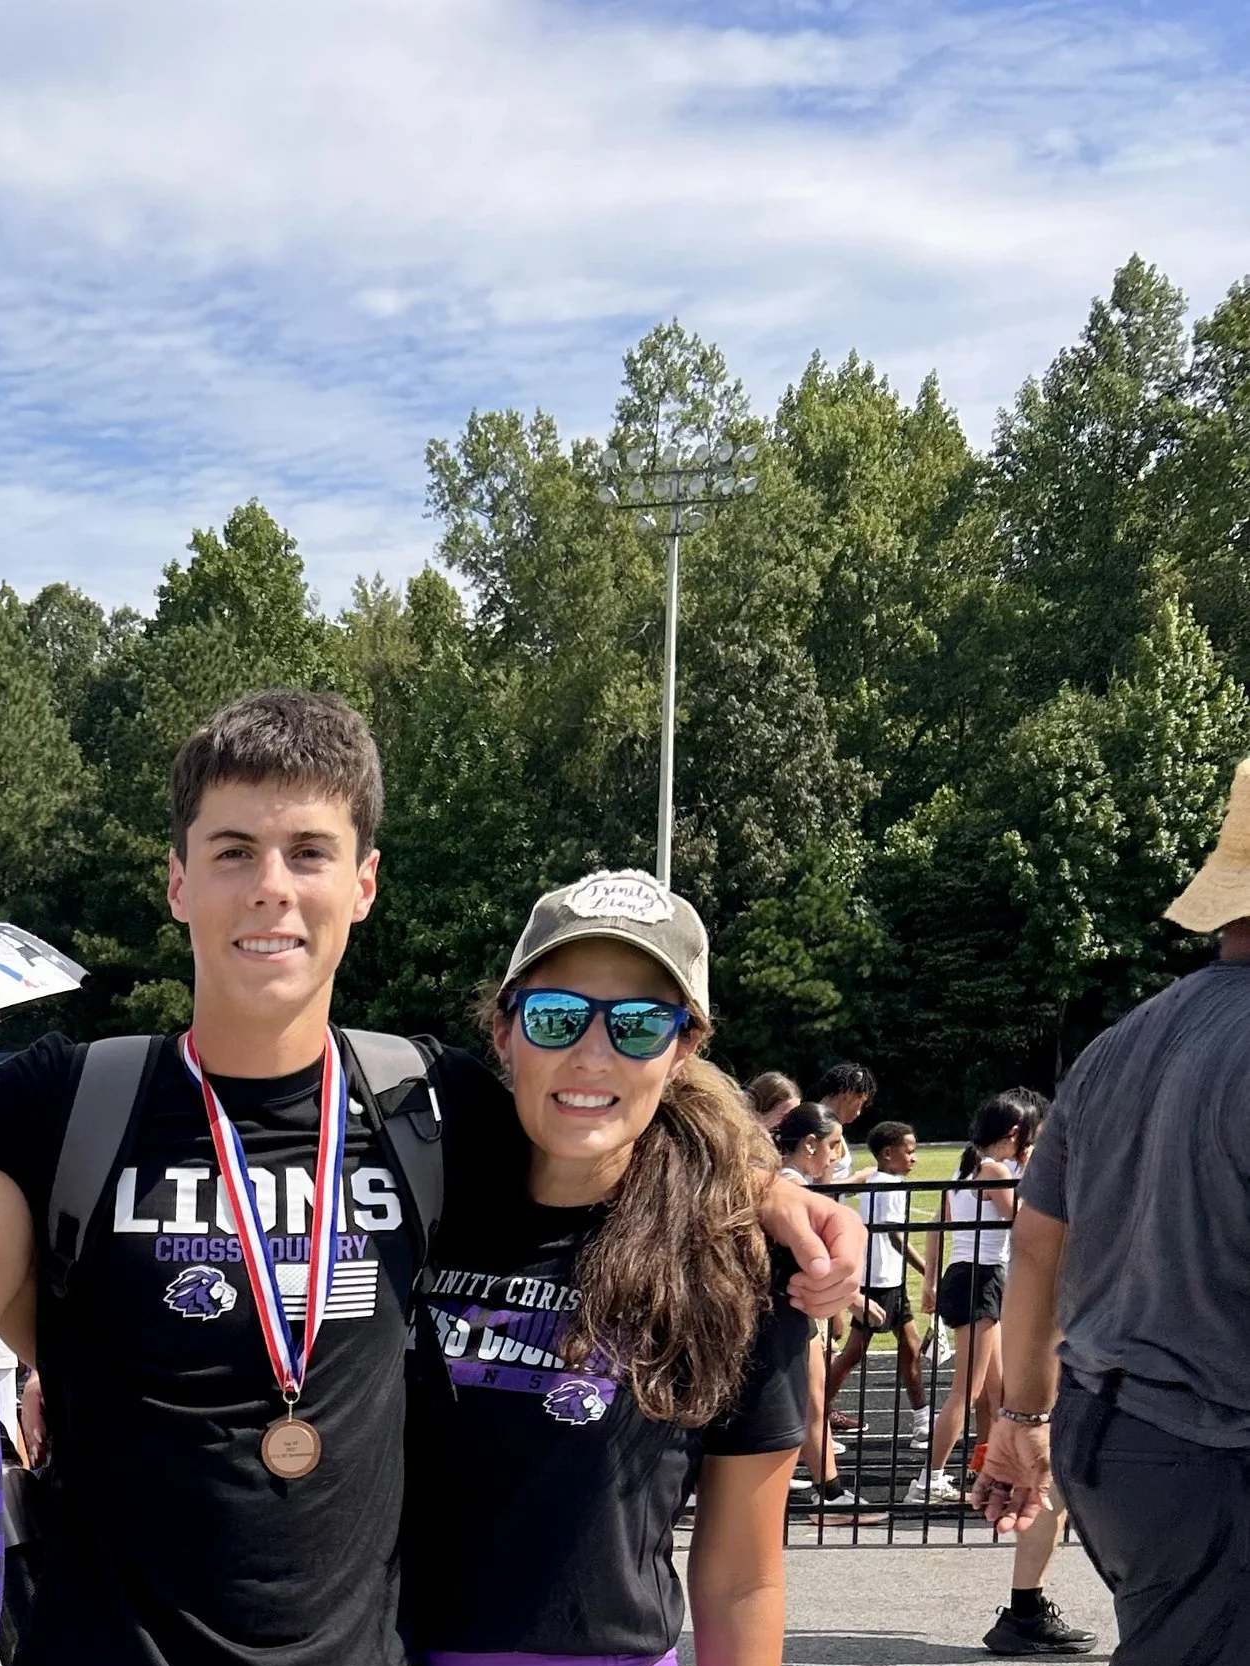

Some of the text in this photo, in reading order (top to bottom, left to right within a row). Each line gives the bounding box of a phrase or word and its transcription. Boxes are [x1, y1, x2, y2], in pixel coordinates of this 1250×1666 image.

[113, 1167, 403, 1234] LIONS
[155, 1235, 368, 1262] CROSS OURY
[431, 1269, 583, 1311] INITY CHRIS
